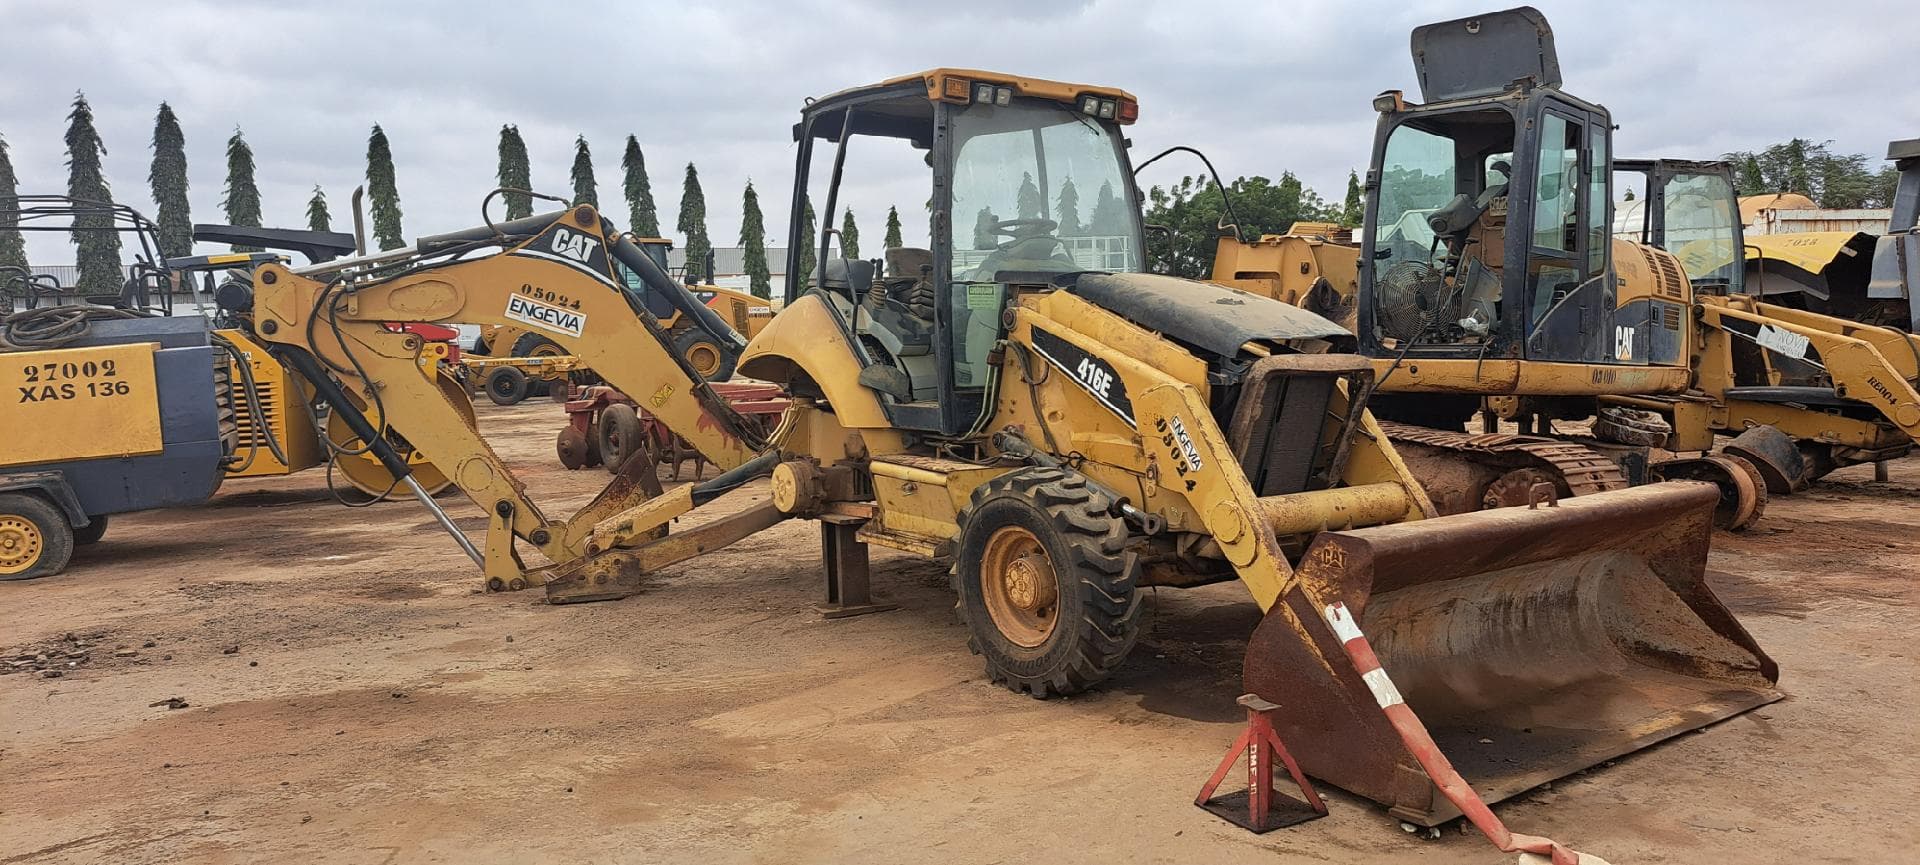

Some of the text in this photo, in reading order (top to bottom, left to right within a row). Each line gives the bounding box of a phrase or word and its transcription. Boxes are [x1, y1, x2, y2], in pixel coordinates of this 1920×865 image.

[551, 228, 598, 263] CAT
[521, 283, 581, 310] 05024
[504, 298, 579, 332] ENGEVIA
[1615, 325, 1635, 361] CAT
[23, 359, 117, 383] 27002
[1077, 357, 1113, 398] 416E
[18, 381, 130, 403] XAS 136
[1156, 417, 1197, 492] 05024
[1171, 415, 1202, 471] ENGEVIA
[1322, 548, 1348, 568] CAT
